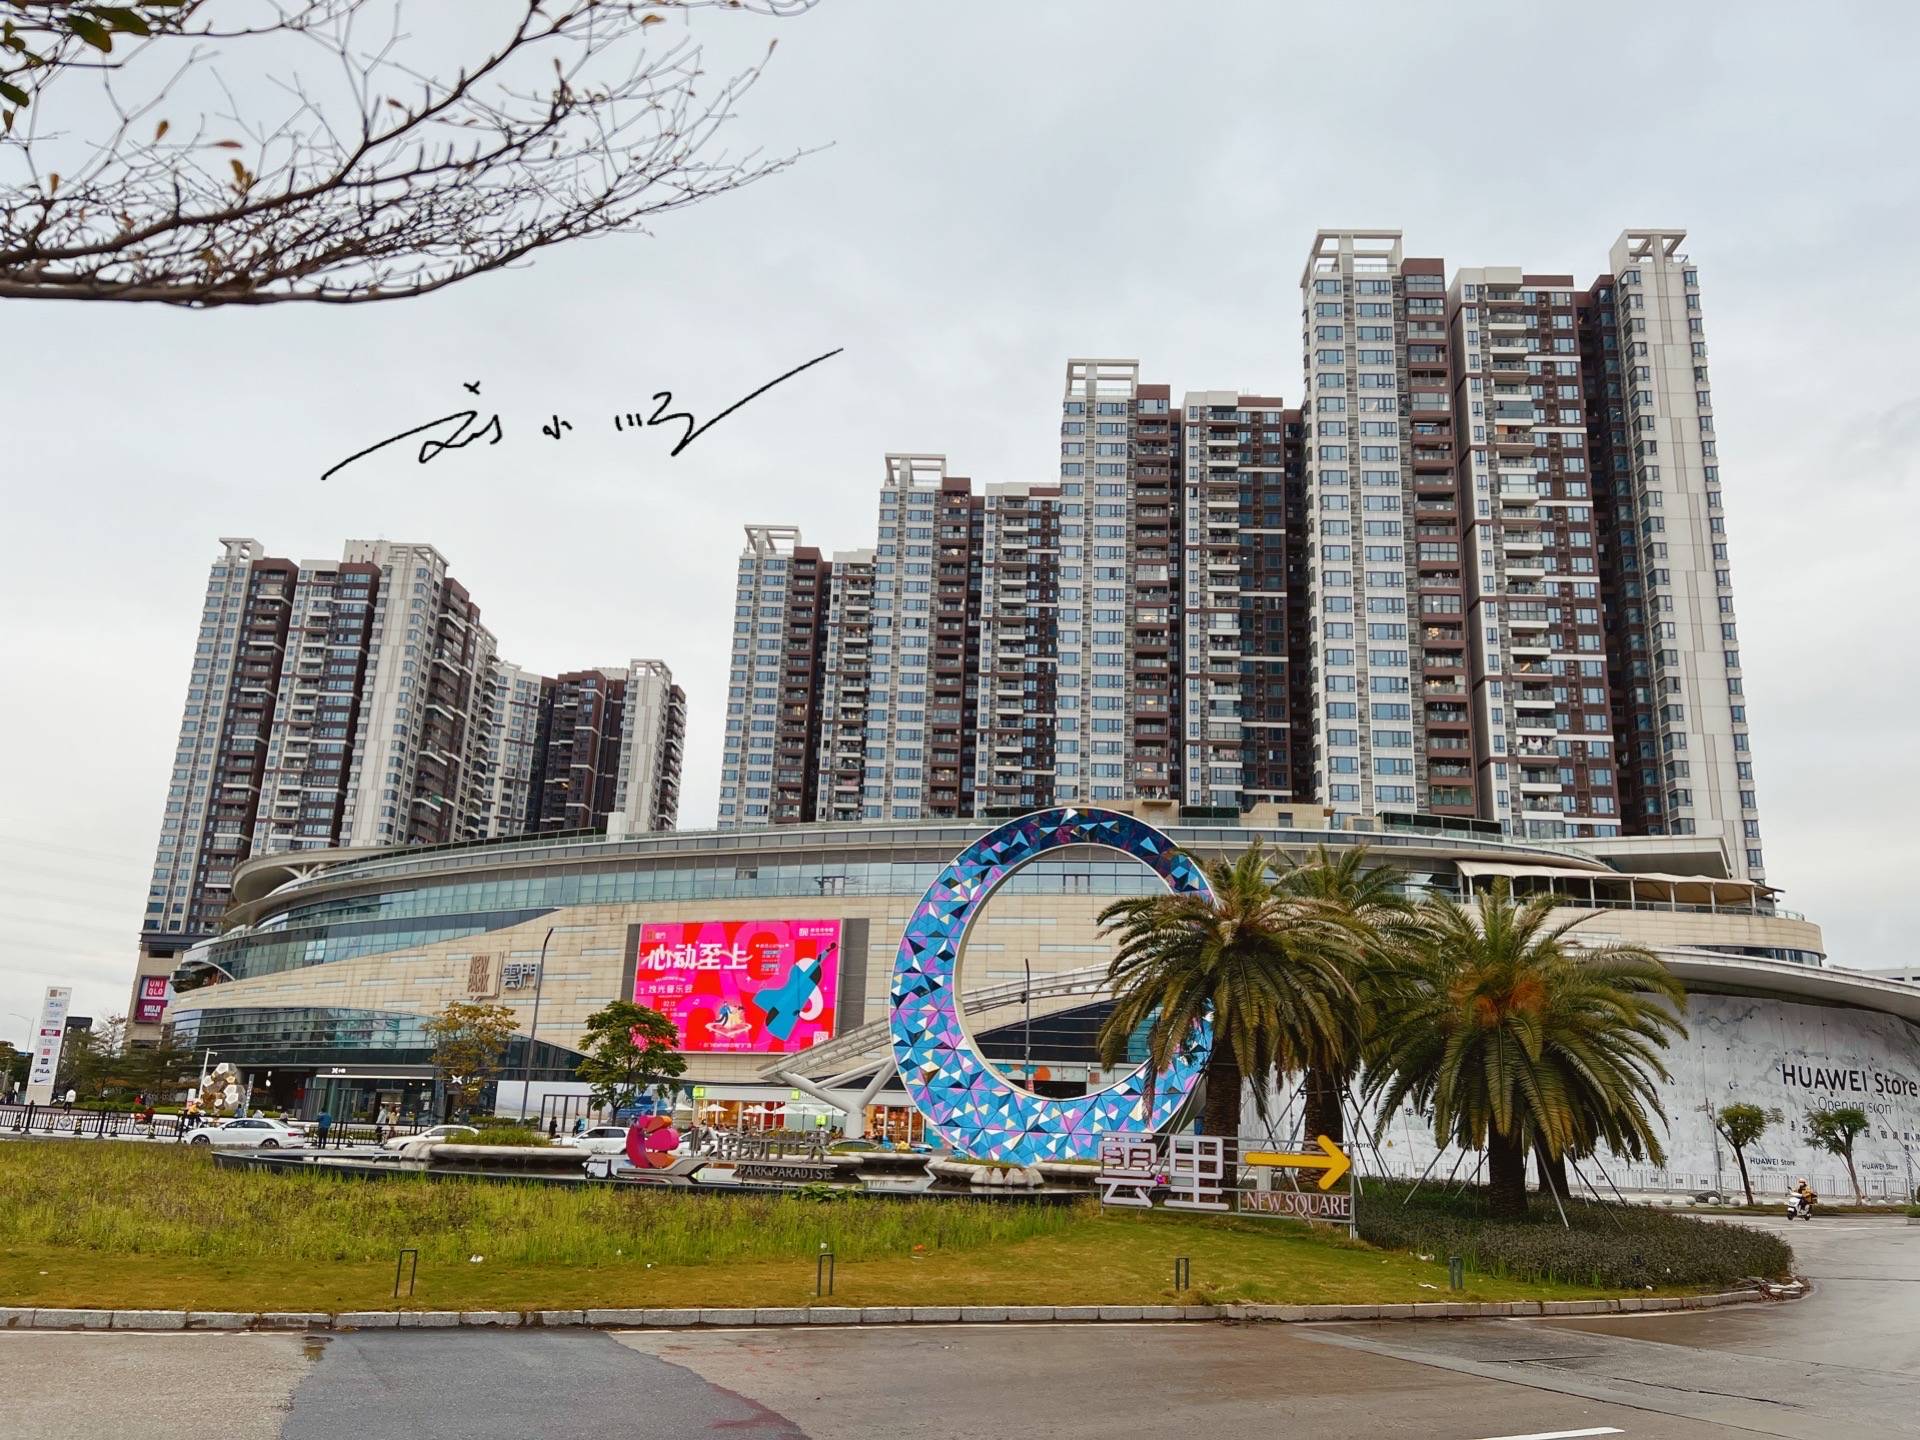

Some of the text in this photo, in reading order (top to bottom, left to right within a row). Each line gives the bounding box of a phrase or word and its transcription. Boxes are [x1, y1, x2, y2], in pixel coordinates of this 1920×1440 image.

[469, 955, 490, 974] NEW
[646, 942, 748, 971] 心动至上
[149, 980, 164, 988] UNI
[467, 974, 490, 993] PARK
[503, 962, 539, 990] 雲門
[148, 988, 163, 996] QLO
[143, 1004, 161, 1013] MUJI
[1781, 1063, 1918, 1098] HUAWEI Store
[1818, 1096, 1892, 1115] Opening soon
[739, 1164, 769, 1177] PARK
[1749, 1157, 1795, 1167] HUAWEI Store
[1862, 1162, 1884, 1171] HUAWEI
[1246, 1192, 1350, 1217] NEW SQUARE
